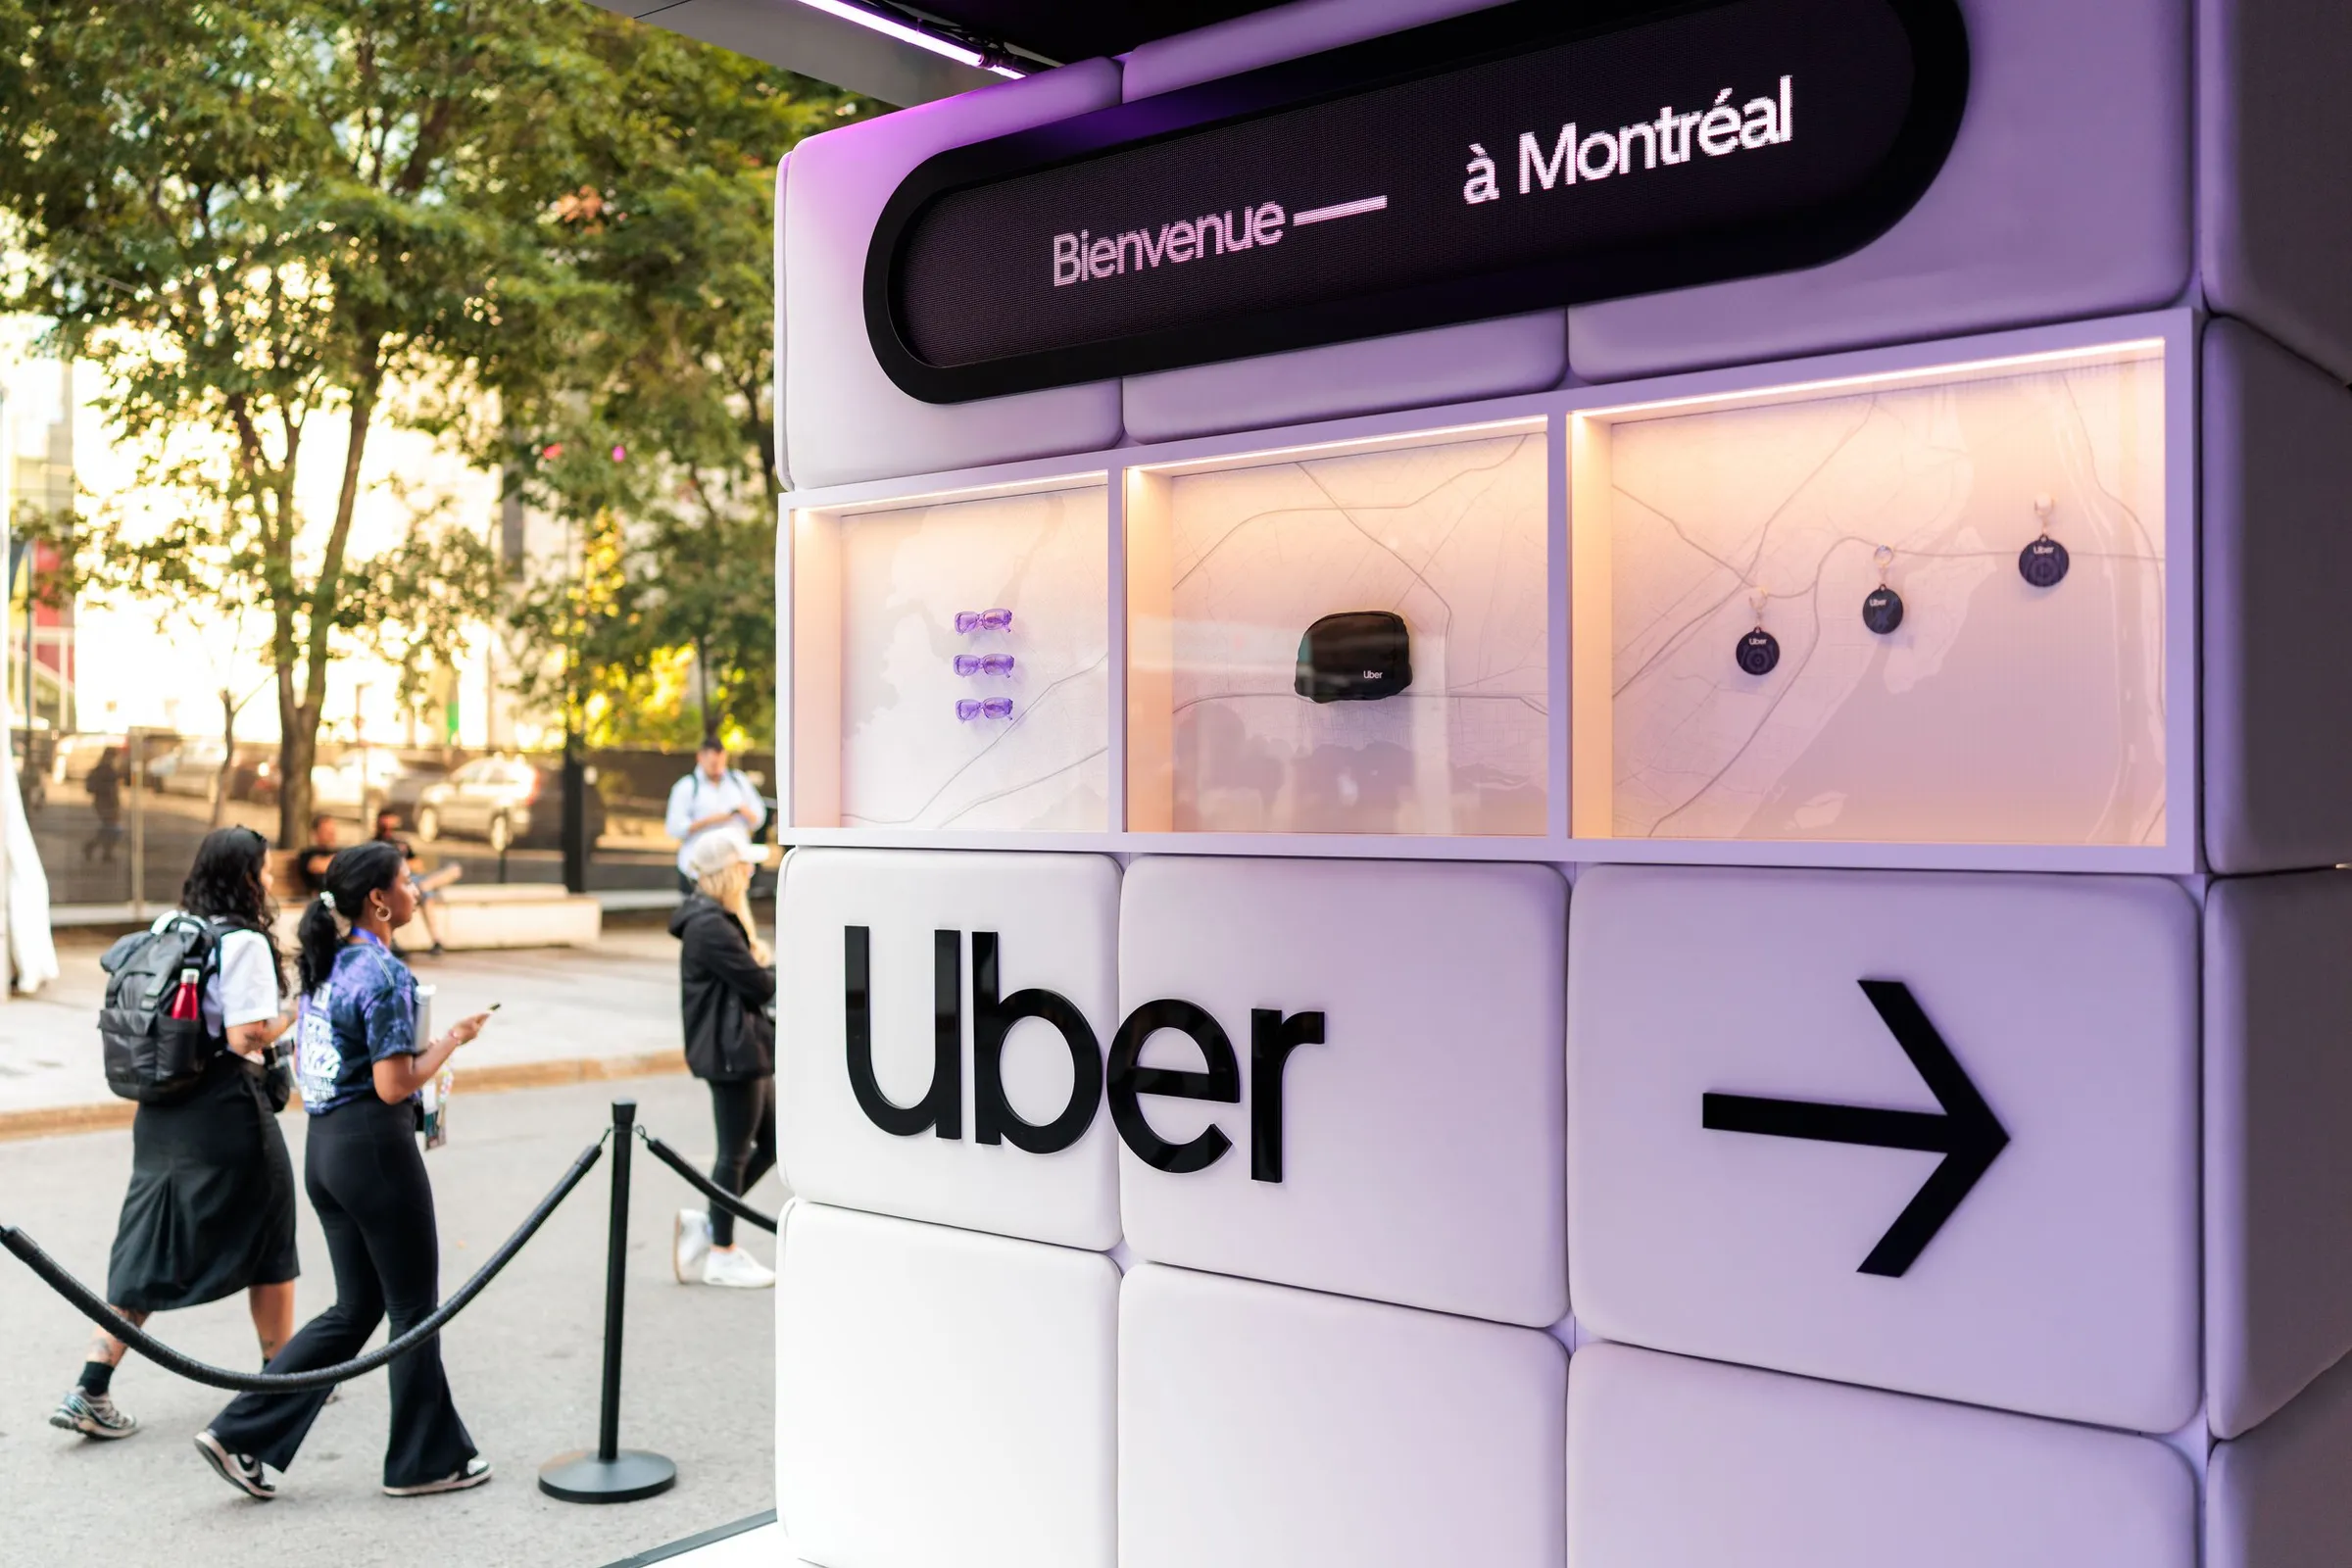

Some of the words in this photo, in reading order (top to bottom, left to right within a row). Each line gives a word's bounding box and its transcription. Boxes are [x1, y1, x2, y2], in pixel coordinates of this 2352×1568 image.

[1463, 143, 1500, 205] à
[1519, 74, 1792, 195] Montréal
[1363, 670, 1383, 679] Uber
[844, 925, 1326, 1184] Uber
